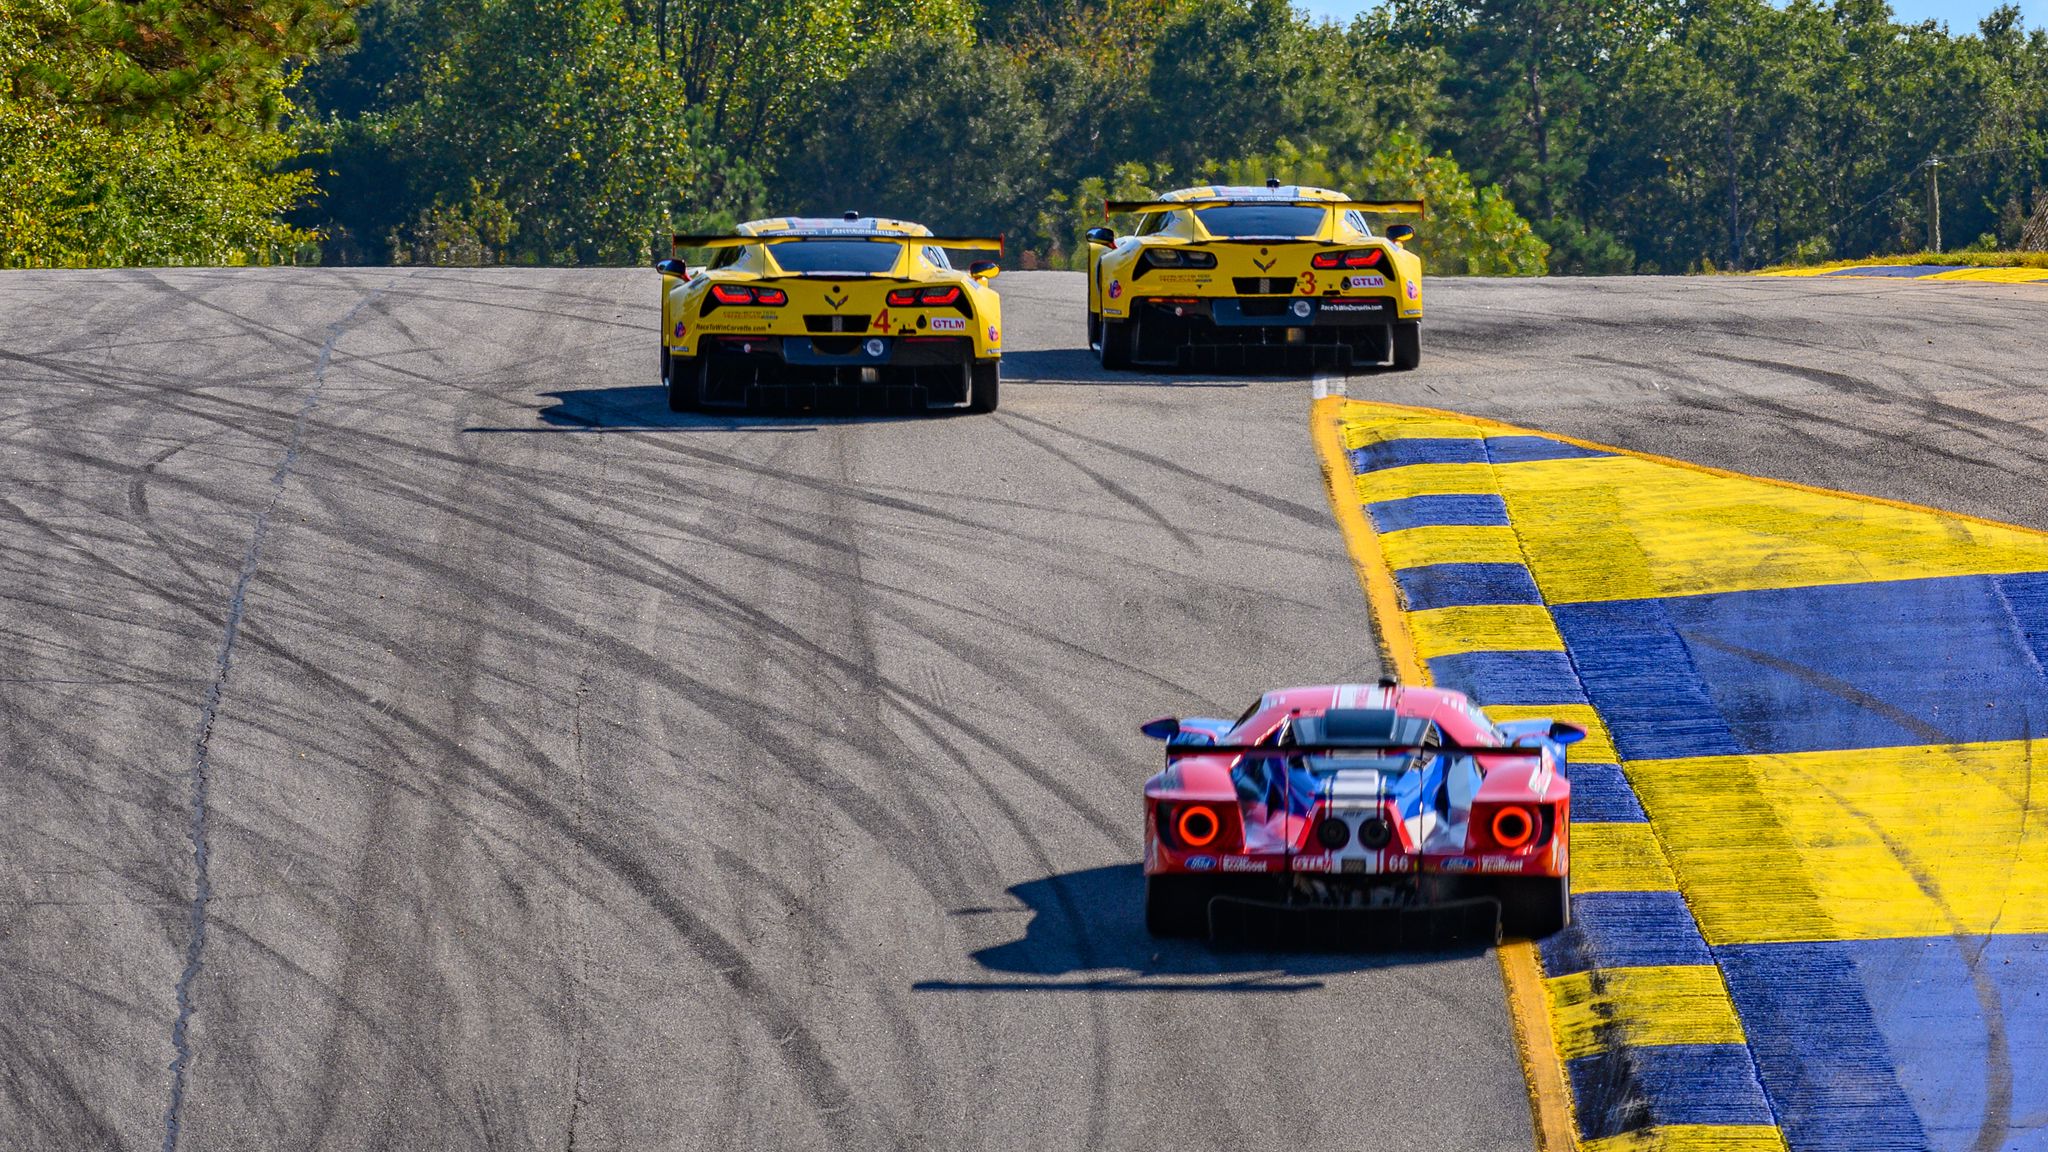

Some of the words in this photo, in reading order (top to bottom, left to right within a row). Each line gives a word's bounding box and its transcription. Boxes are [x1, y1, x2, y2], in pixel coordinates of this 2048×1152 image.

[1299, 271, 1316, 295] 3
[1352, 277, 1384, 287] GTLM
[872, 308, 891, 334] 4
[933, 319, 965, 329] GTLM
[1388, 854, 1409, 873] 66
